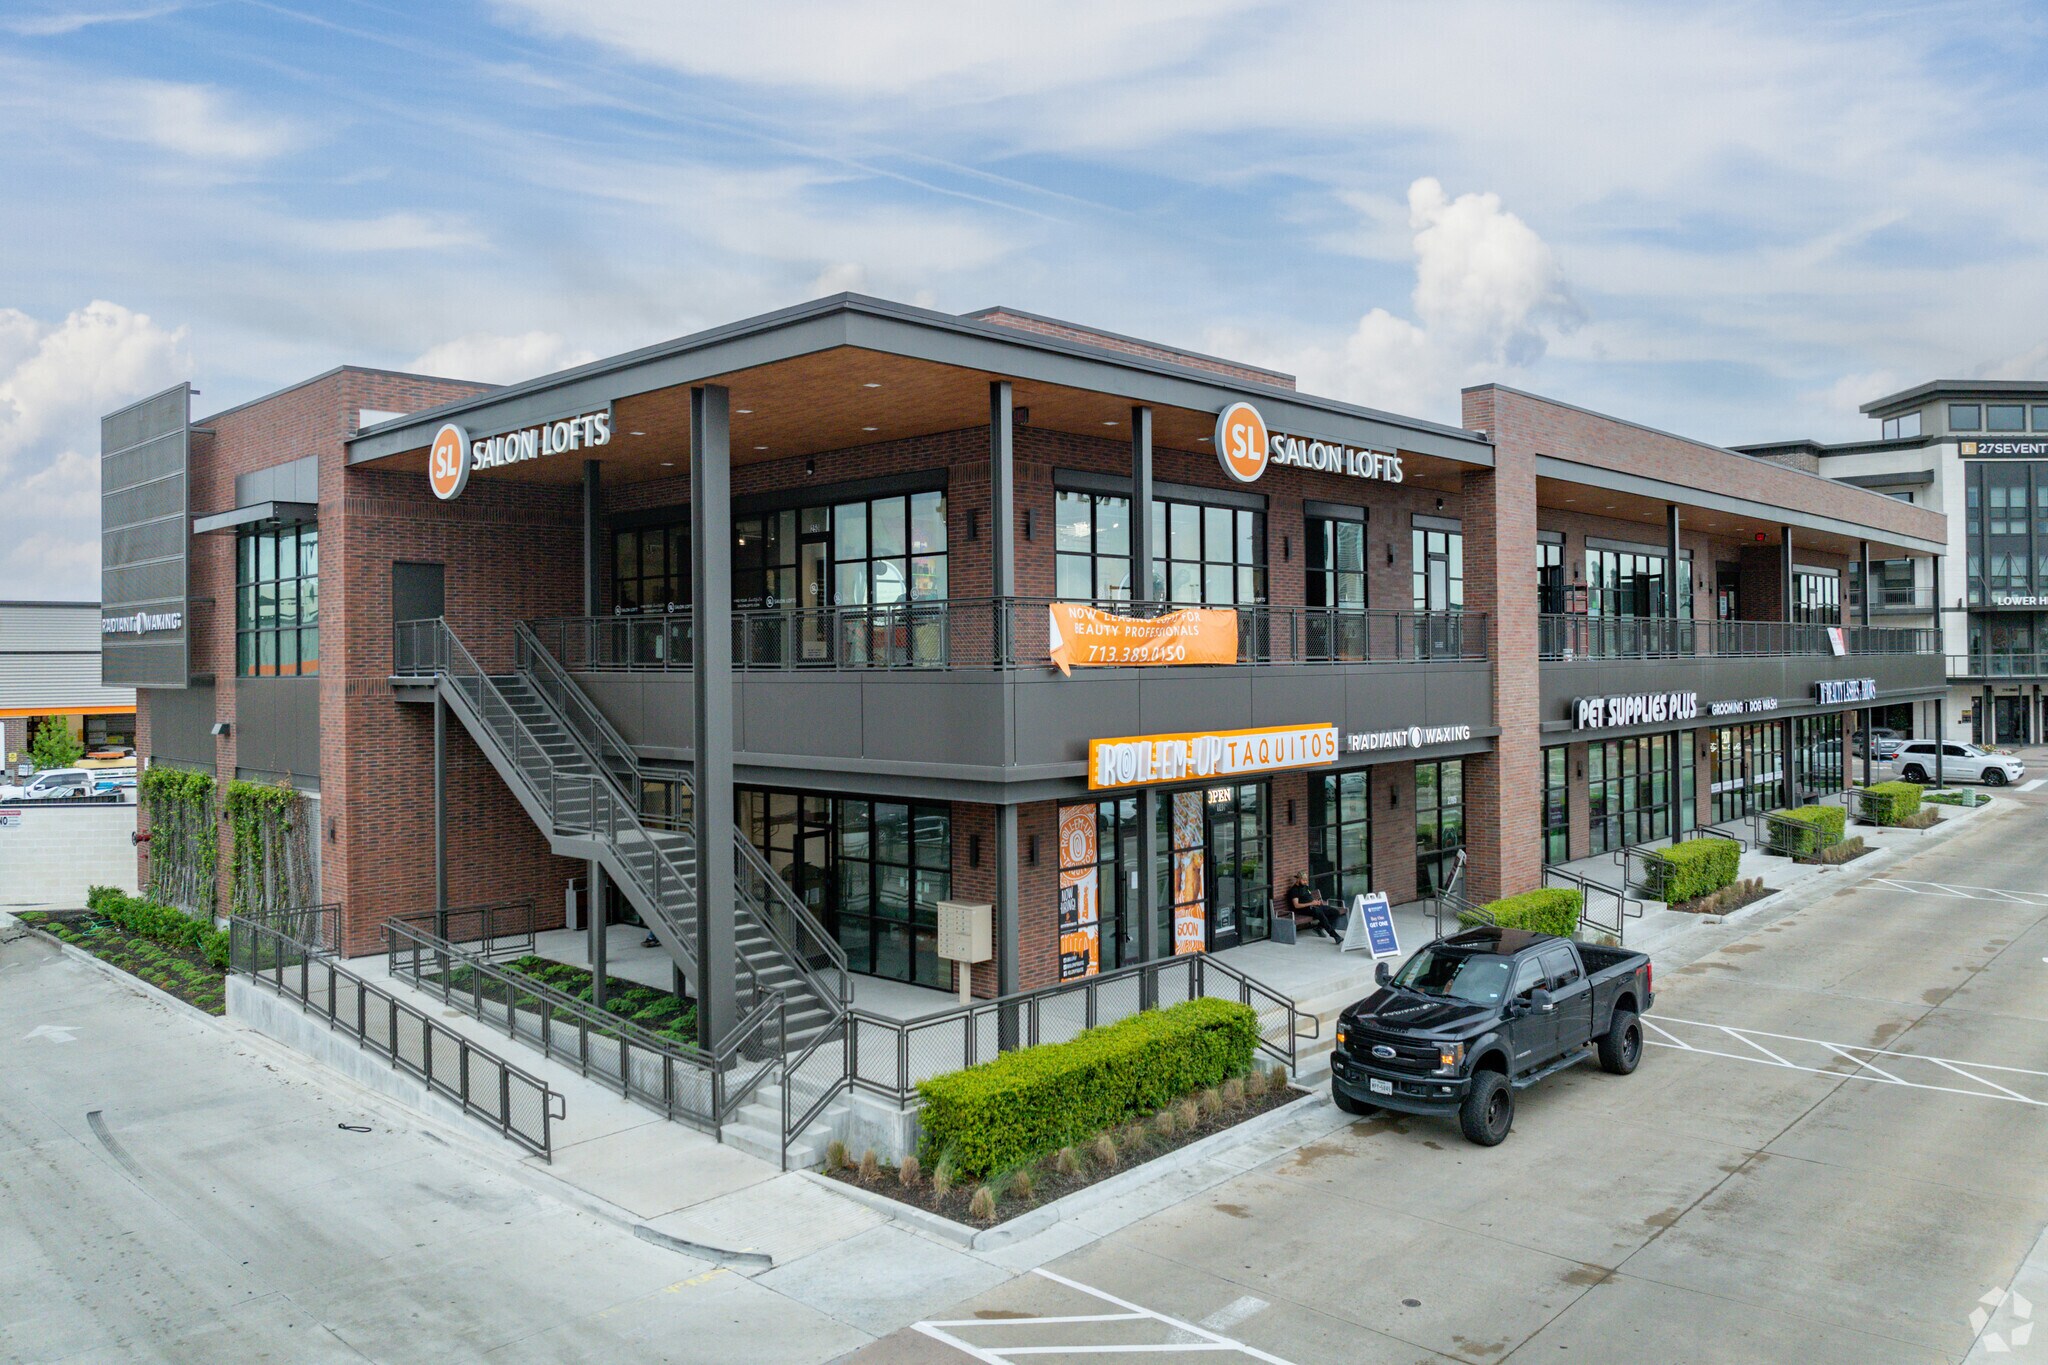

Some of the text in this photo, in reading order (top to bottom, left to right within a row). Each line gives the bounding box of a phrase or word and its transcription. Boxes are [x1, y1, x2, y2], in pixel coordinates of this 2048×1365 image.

[472, 413, 611, 471] SALON LOFTS
[1231, 424, 1261, 460] SL
[1979, 443, 2048, 454] 27SEVENT
[436, 444, 457, 479] SL
[1270, 435, 1404, 483] SALON LOFTS
[1998, 596, 2037, 606] LOWER
[1068, 607, 1097, 620] NOW
[1182, 611, 1200, 622] FOR
[102, 616, 135, 633] RADIANT
[1074, 622, 1199, 637] BEAUTY PROFESSIONALS
[1088, 645, 1186, 662] 713.389.0150
[1579, 692, 1697, 729] PET SUPPLIES PLUS
[1711, 701, 1743, 716] GROOMING
[1750, 699, 1762, 712] DOG
[1762, 698, 1778, 711] WASH
[1351, 725, 1470, 751] RADIANT WAXING
[1228, 731, 1335, 768] TAQUITOS
[1177, 921, 1199, 937] SOON
